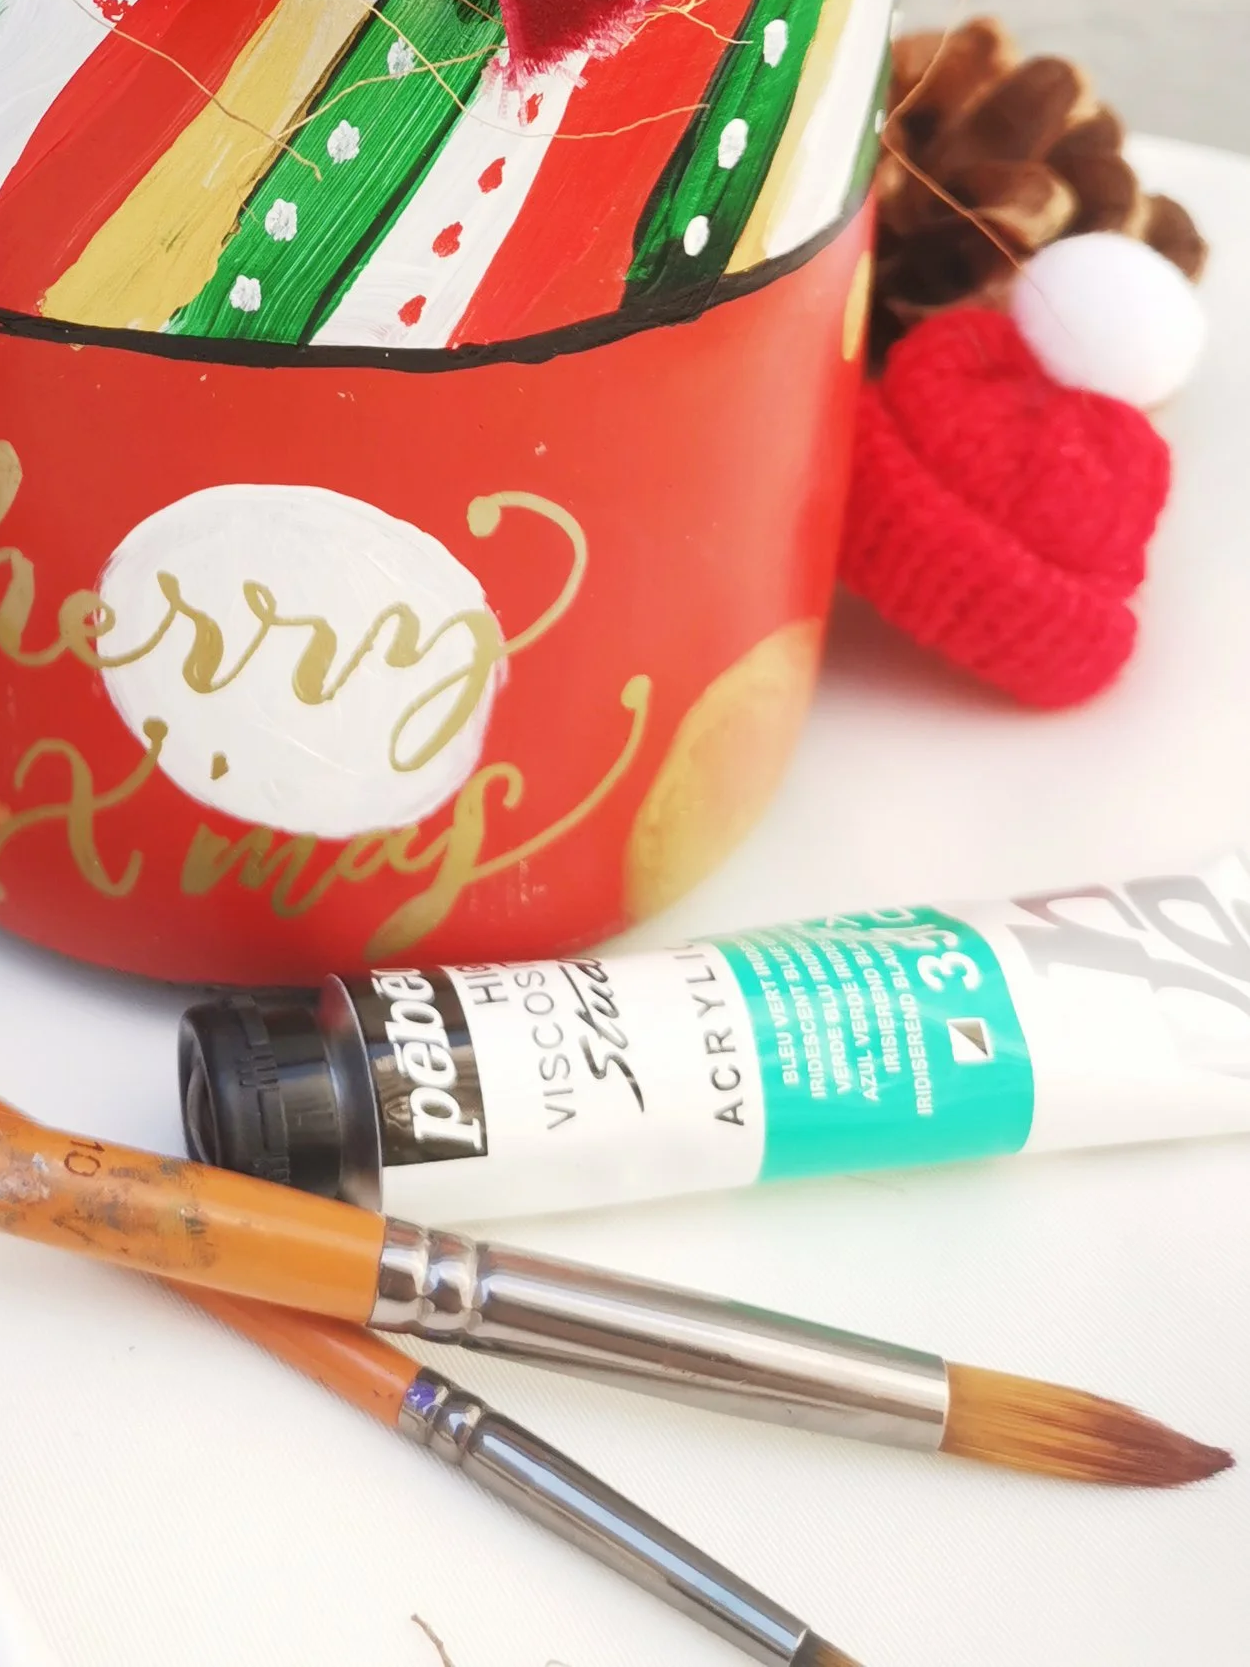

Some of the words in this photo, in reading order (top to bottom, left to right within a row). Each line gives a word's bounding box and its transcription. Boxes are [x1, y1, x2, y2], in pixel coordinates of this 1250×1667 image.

[666, 945, 745, 1127] ACRYLI
[760, 979, 789, 1028] VERT
[816, 984, 841, 1025] BLU
[841, 981, 871, 1048] VERDE
[862, 967, 901, 1074] IRISIEREND
[776, 1031, 799, 1086] BLEU
[789, 985, 827, 1099] IRIDESCENT
[826, 1025, 852, 1095] VERDE
[856, 1048, 879, 1102] AZUL
[898, 992, 934, 1117] IRIDISEREND
[62, 1138, 106, 1179] 10
